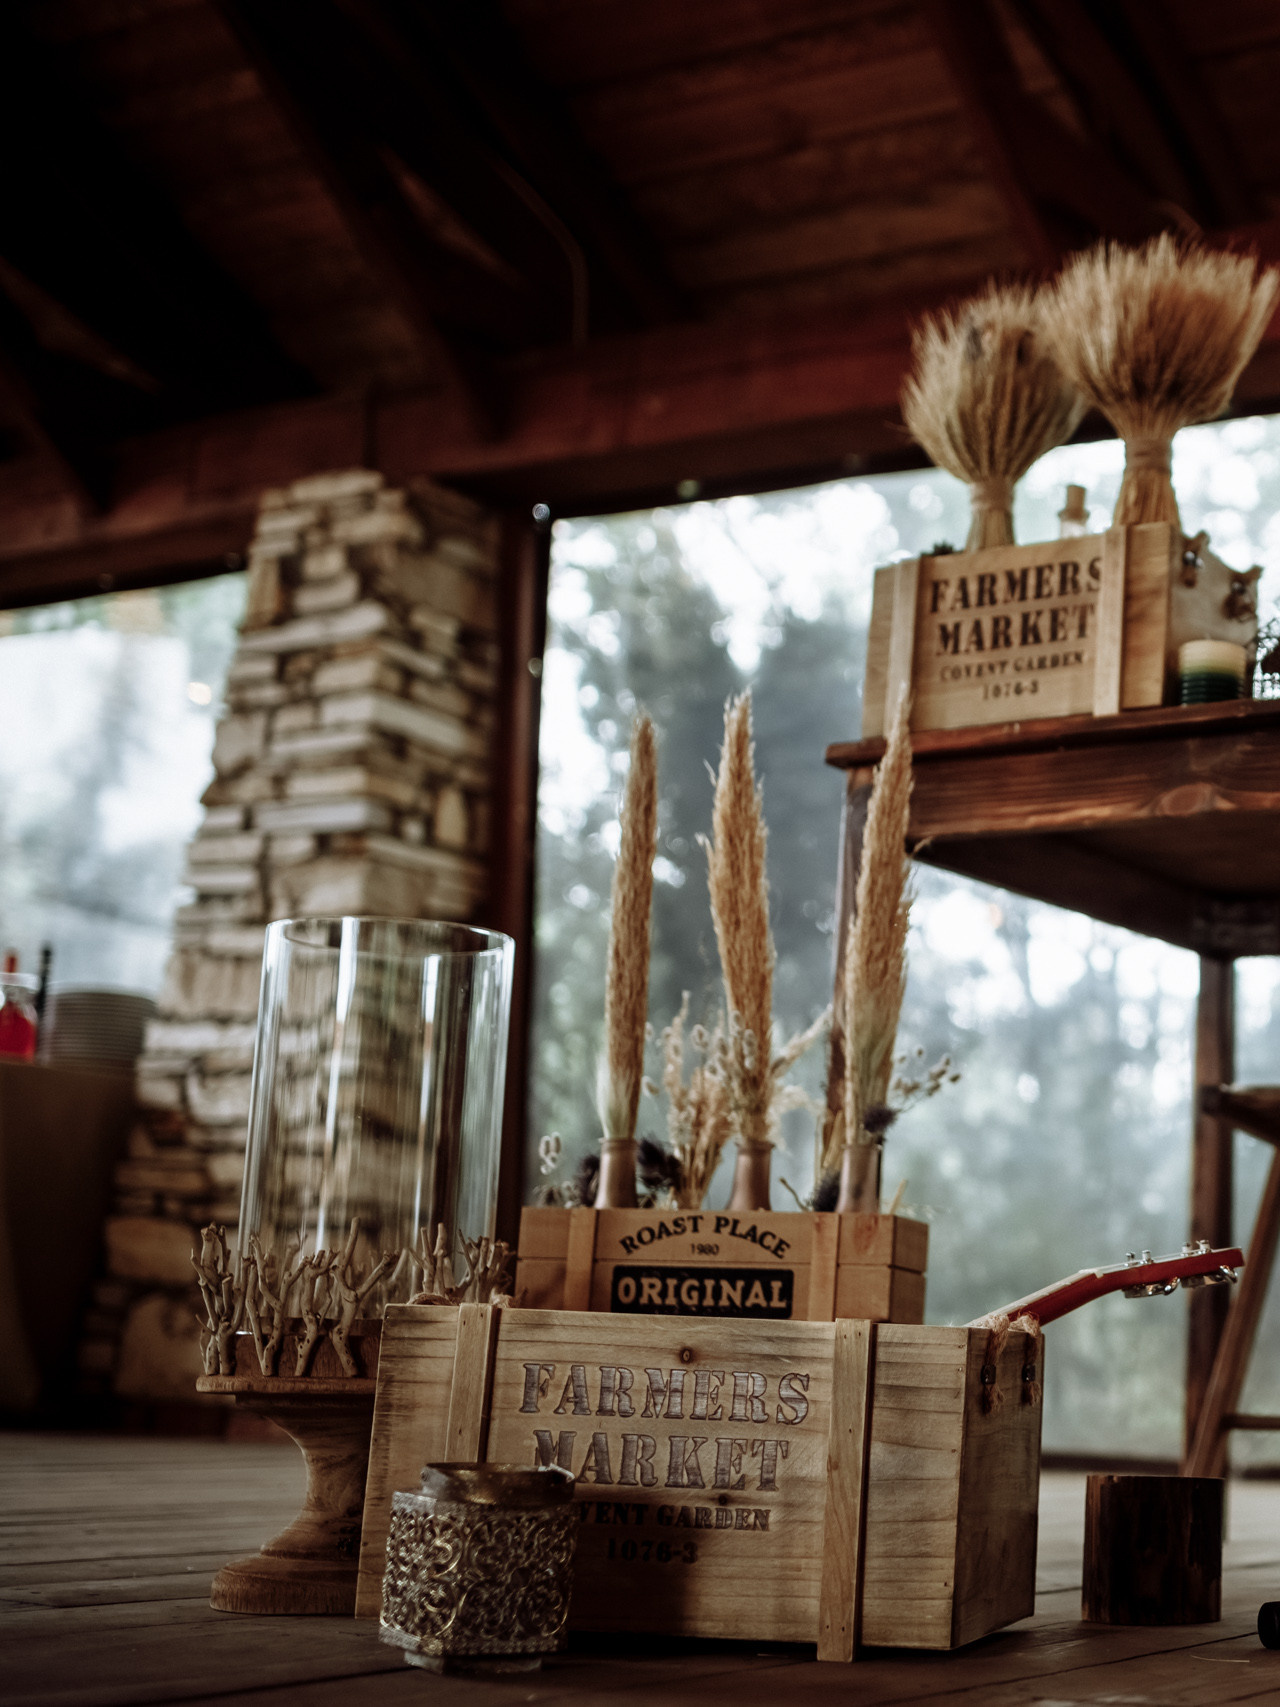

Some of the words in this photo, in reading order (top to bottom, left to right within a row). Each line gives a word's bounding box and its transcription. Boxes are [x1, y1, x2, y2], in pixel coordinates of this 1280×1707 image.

[930, 556, 1102, 614] FARMERS
[935, 601, 1096, 656] MARKET
[940, 660, 1009, 682] COVENT
[1013, 651, 1085, 672] GARDEN
[618, 1215, 705, 1256] ROAST
[713, 1215, 791, 1259] PLACE
[617, 1276, 787, 1309] ORIGINAL
[518, 1362, 811, 1425] FARMERS
[532, 1429, 791, 1492] MARKET
[579, 1501, 649, 1526] VENT
[656, 1504, 772, 1532] GARDEN
[607, 1538, 699, 1564] 1076-3
